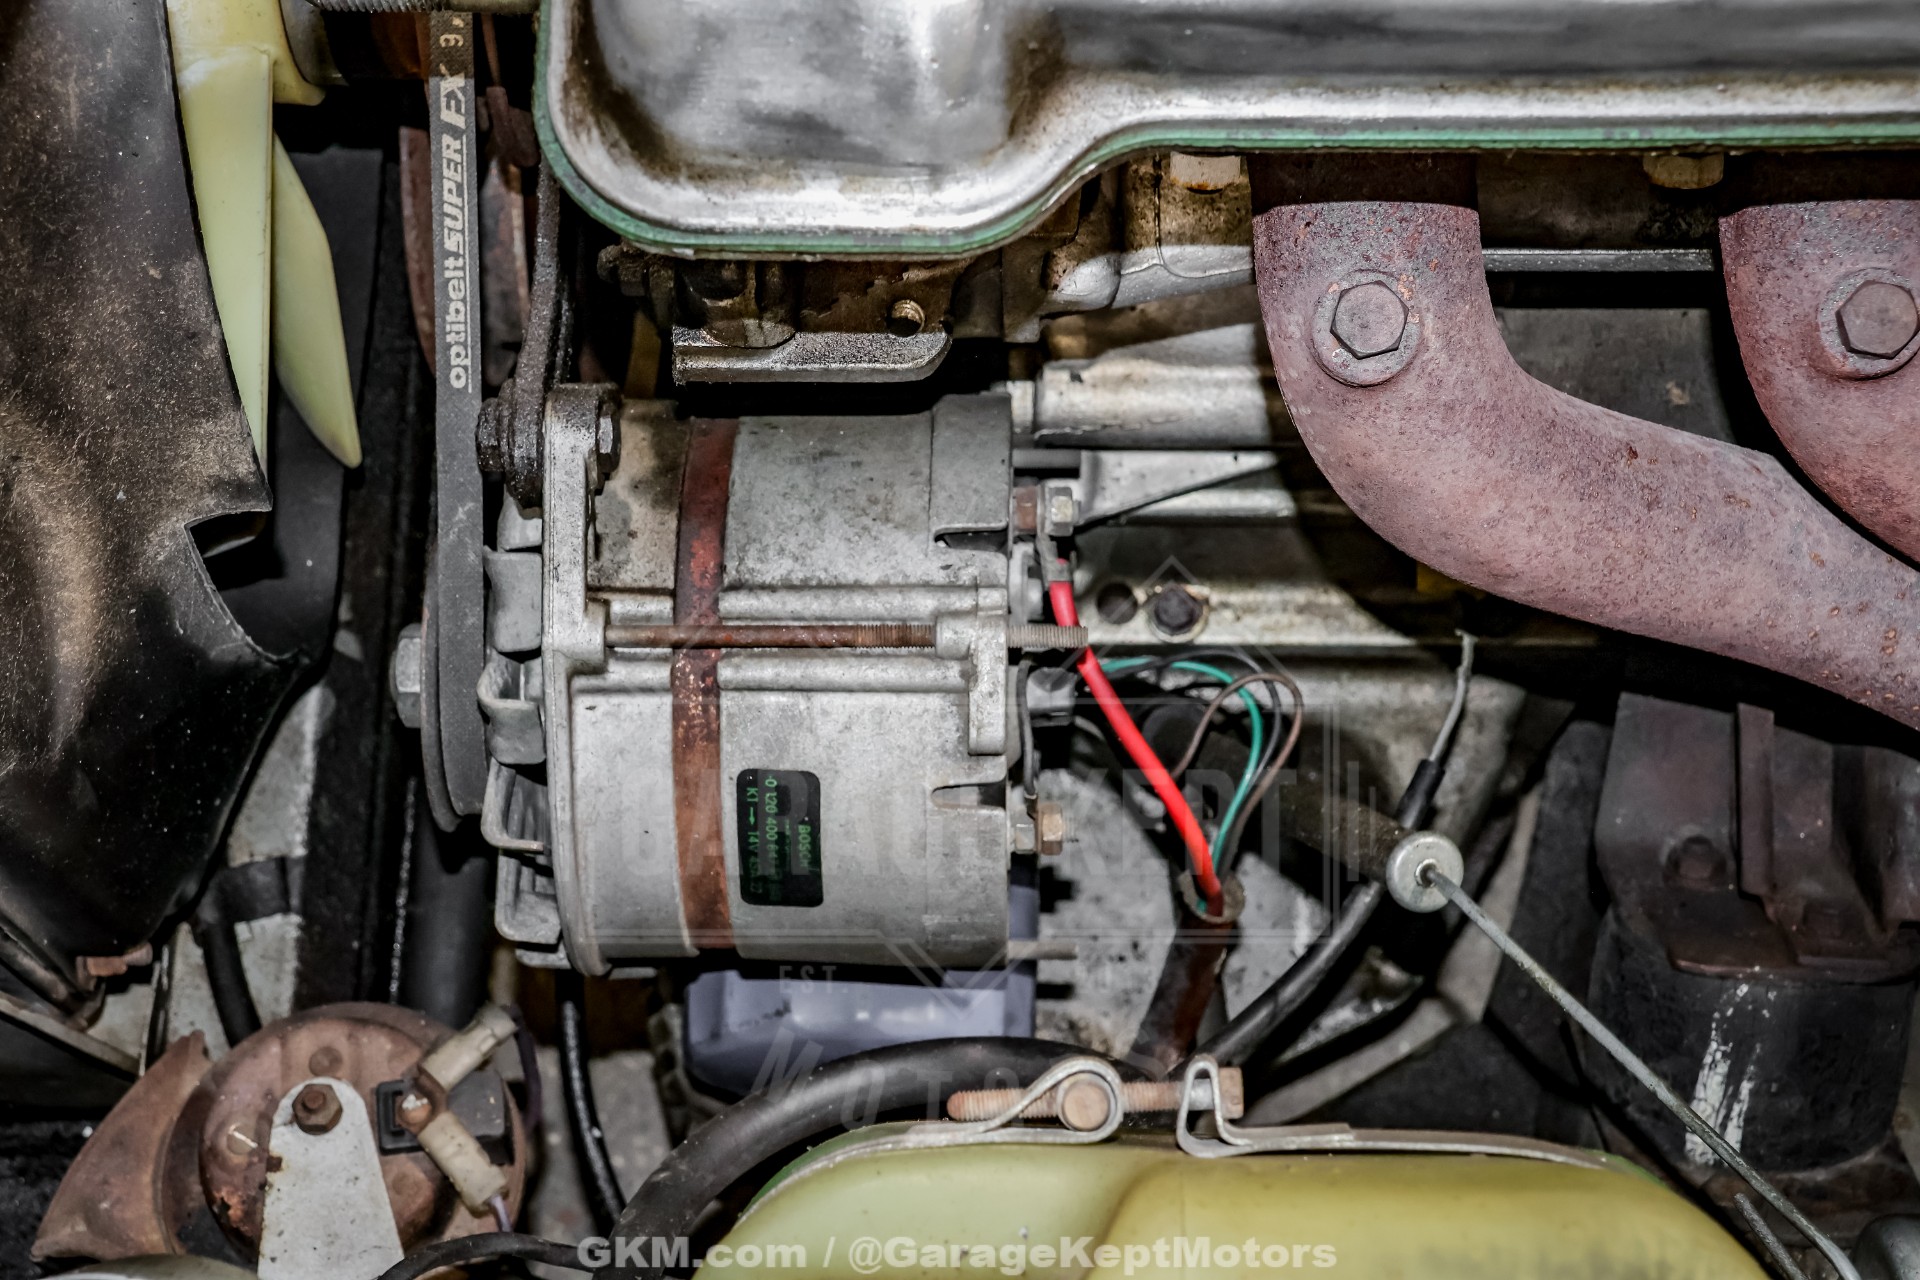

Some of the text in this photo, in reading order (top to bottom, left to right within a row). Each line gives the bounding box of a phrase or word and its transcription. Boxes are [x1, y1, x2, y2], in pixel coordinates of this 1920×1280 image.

[441, 134, 465, 254] SUPER
[443, 256, 471, 389] optibelt
[766, 817, 778, 841] 400
[798, 824, 811, 868] BOSCH
